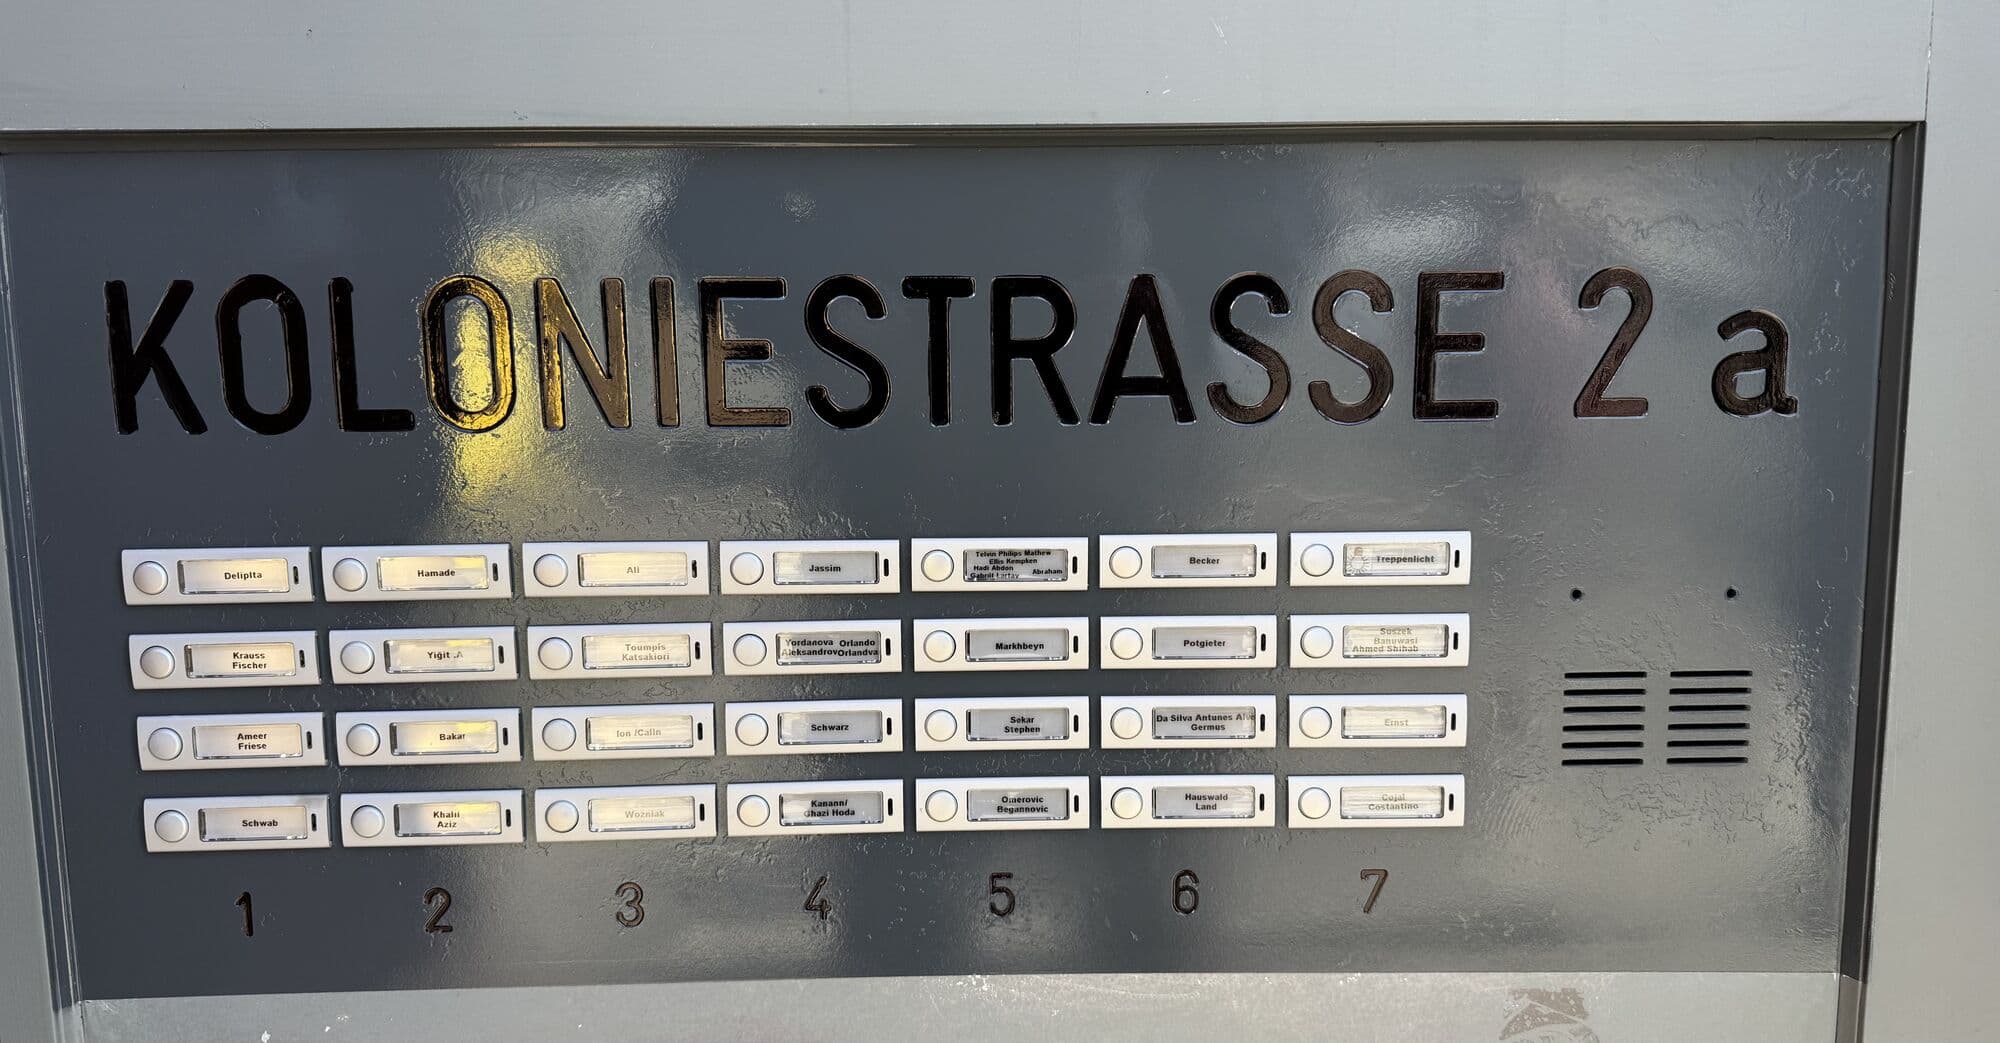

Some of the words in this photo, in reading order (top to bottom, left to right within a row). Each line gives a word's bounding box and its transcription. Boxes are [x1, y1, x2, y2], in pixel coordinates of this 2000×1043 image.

[104, 269, 1506, 436] KOLONIESTRASSE
[1573, 266, 1653, 420] 2
[1710, 308, 1799, 419] a
[1024, 549, 1051, 557] Mathew
[1189, 557, 1220, 565] Becker
[1376, 555, 1435, 564] Treppenlicht
[626, 566, 640, 574] Ali
[809, 564, 841, 572] Jassim
[1032, 568, 1063, 576] Abraham
[417, 569, 456, 577] Hamade
[785, 639, 834, 647] Yordanova
[839, 639, 876, 648] Orlando
[1183, 639, 1226, 649] Potgieter
[1351, 646, 1384, 654] Ahmed
[232, 651, 266, 660] Krauss
[232, 661, 267, 670] Fischer
[1010, 716, 1035, 724] Sekar
[1156, 714, 1169, 723] Da
[1171, 714, 1193, 723] Silva
[1195, 713, 1233, 722] Antunes
[1384, 719, 1409, 727] Ernst
[811, 723, 850, 732] Schwarz
[1004, 726, 1041, 735] Stephen
[1190, 724, 1226, 732] Germus
[237, 733, 268, 741] Ameer
[439, 733, 466, 741] Bakar
[238, 742, 268, 750] Friese
[1001, 796, 1044, 804] Omerovic
[1185, 793, 1228, 801] Hauswald
[1195, 803, 1217, 811] Land
[832, 808, 856, 817] Hoda
[242, 819, 279, 828] Schwab
[437, 821, 457, 829] Aziz
[234, 891, 254, 937] 1
[422, 886, 453, 933] 2
[614, 881, 645, 928] 3
[804, 876, 832, 921] 4
[989, 871, 1016, 917] 5
[1172, 868, 1200, 915] 6
[1359, 867, 1390, 914] 7
